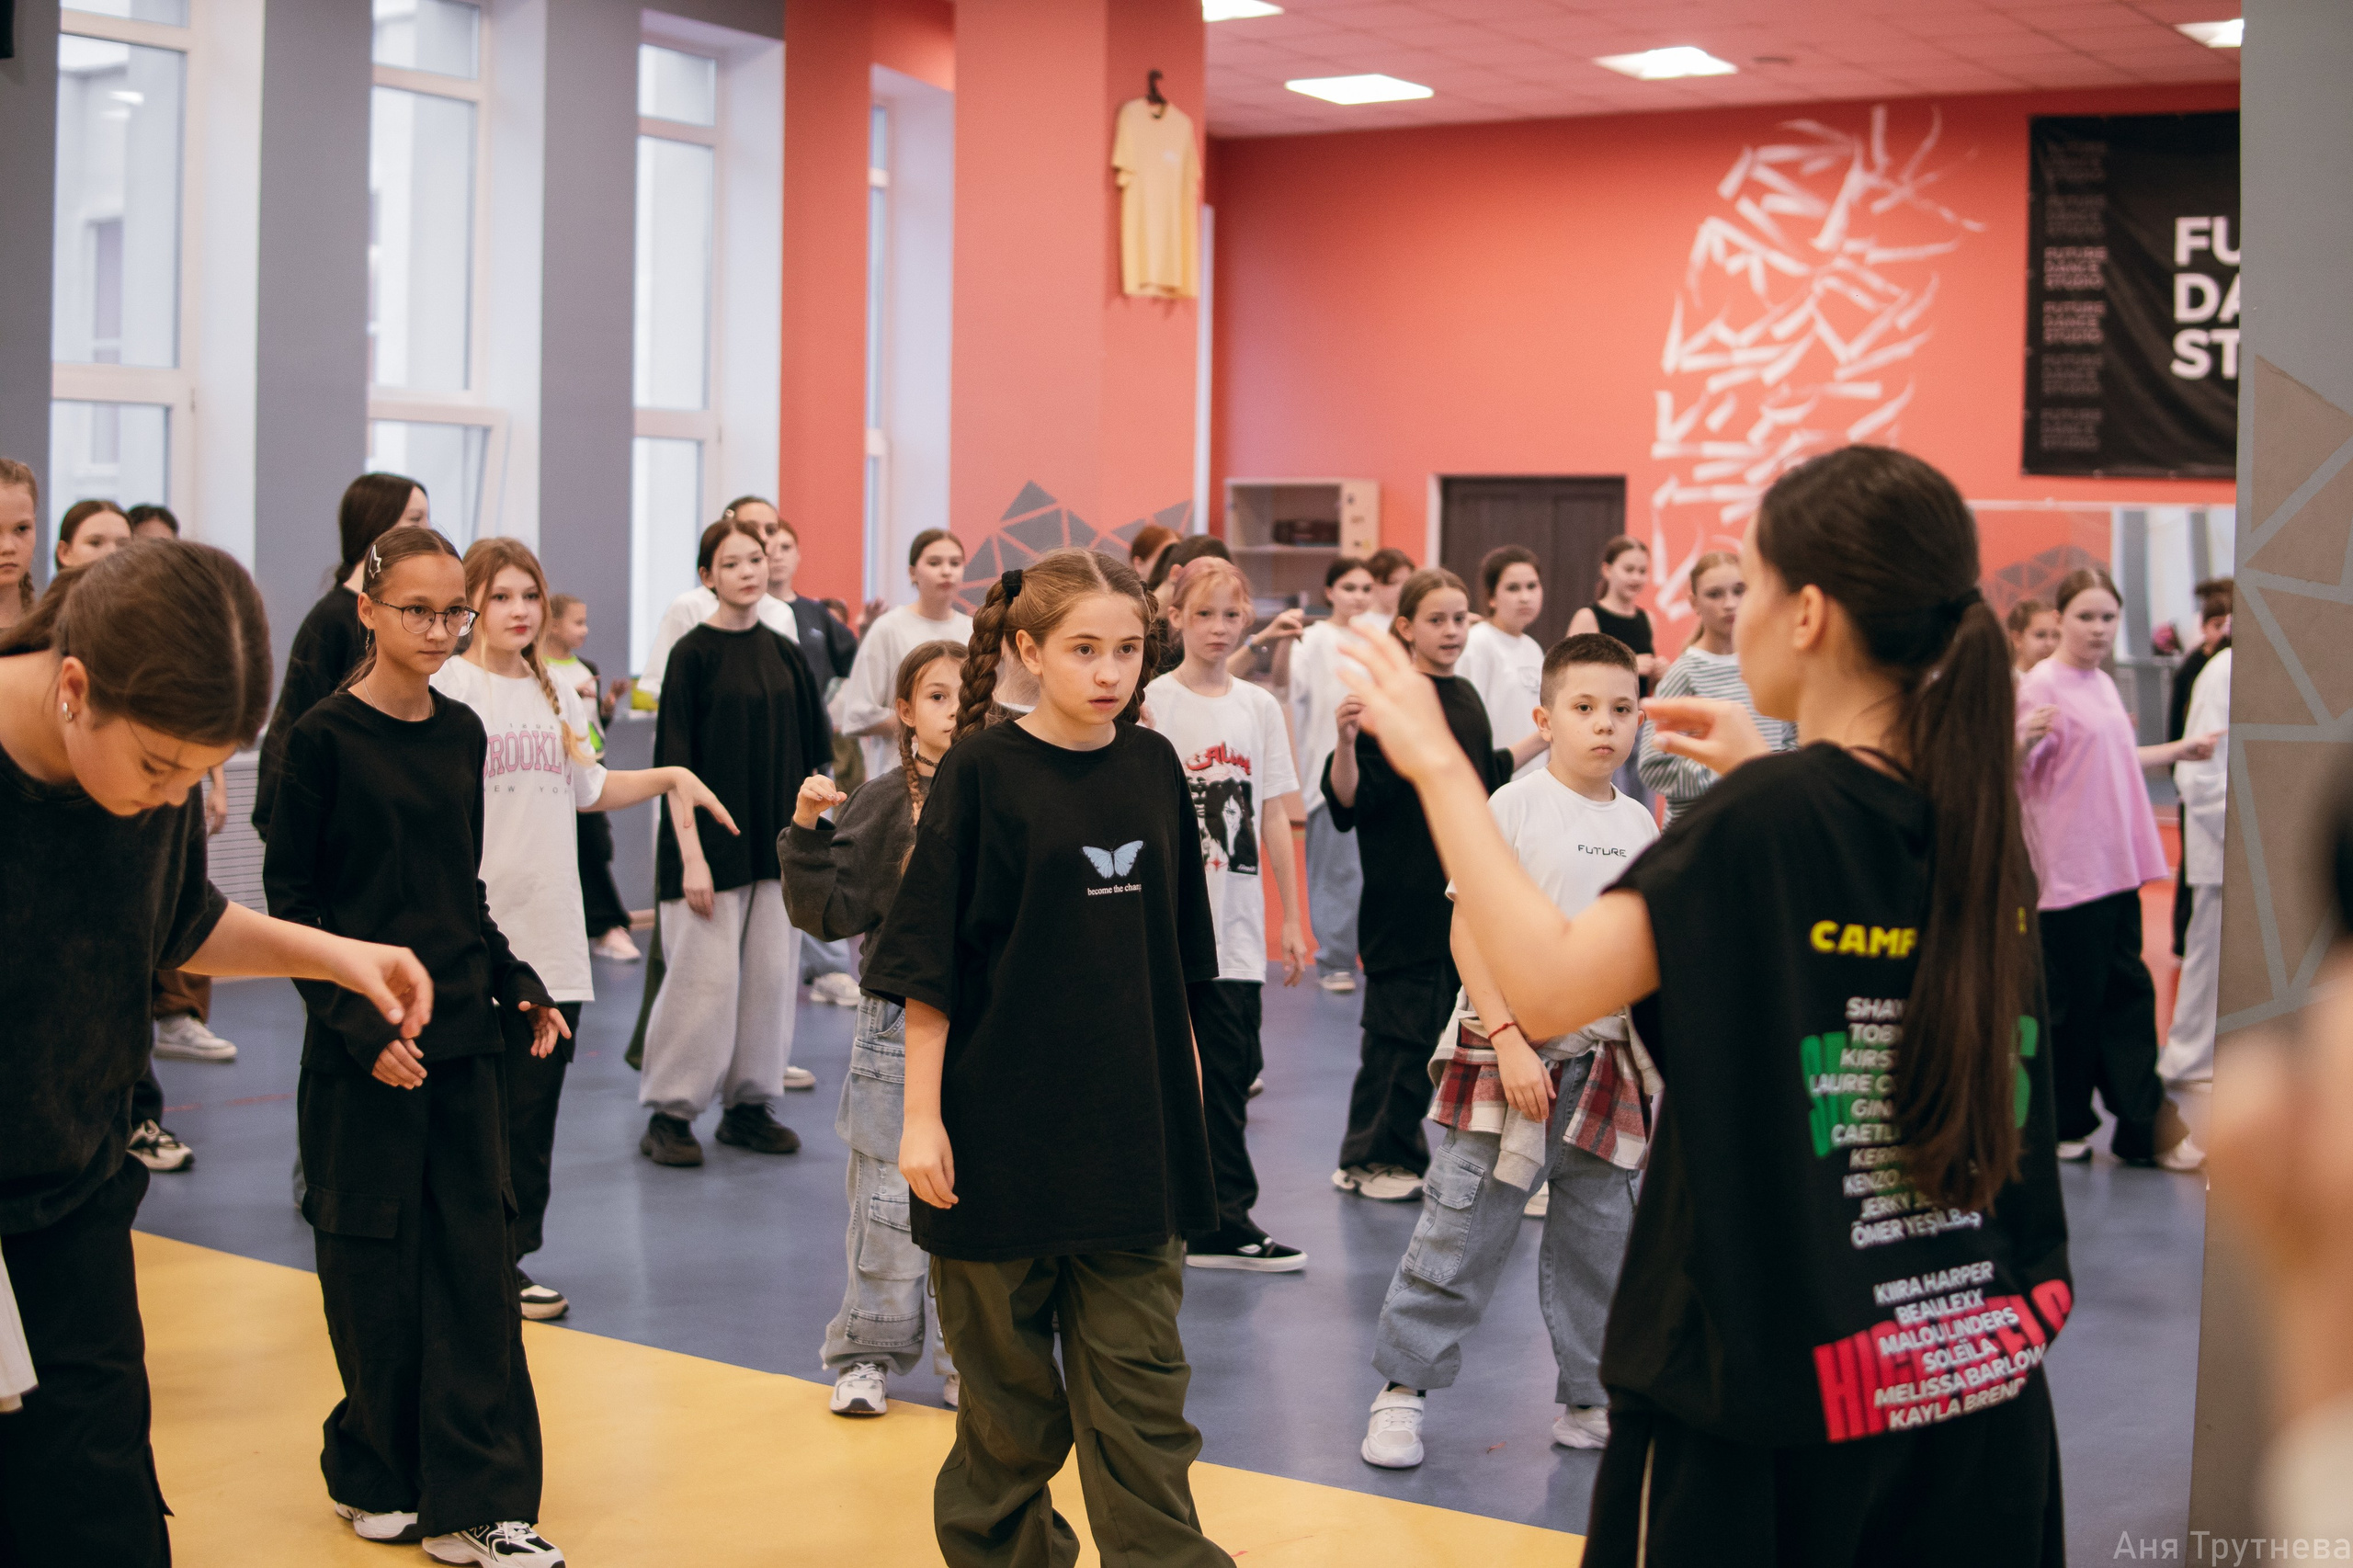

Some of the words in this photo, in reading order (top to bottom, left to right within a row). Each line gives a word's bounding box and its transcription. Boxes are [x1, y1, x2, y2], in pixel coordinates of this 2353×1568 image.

[2169, 328, 2240, 381] ST
[483, 730, 573, 785] ROOKL
[539, 785, 569, 794] YO
[1577, 844, 1627, 858] FUTURE
[1087, 886, 1113, 896] become
[1113, 884, 1124, 893] the
[1848, 1022, 1904, 1046] TOB
[1840, 1048, 1899, 1071] KIRS
[1809, 1073, 1874, 1098] LAURE
[1850, 1097, 1894, 1120] GIN
[1843, 1167, 1902, 1198] KENZO
[1850, 1218, 1907, 1251] ÖMER
[1922, 1260, 1995, 1292] HARPER
[1922, 1337, 2000, 1374] SOLEÏLA
[1873, 1374, 1967, 1409] MELISSA
[1963, 1342, 2048, 1390] BARLOW
[1888, 1397, 1962, 1432] KAYLA
